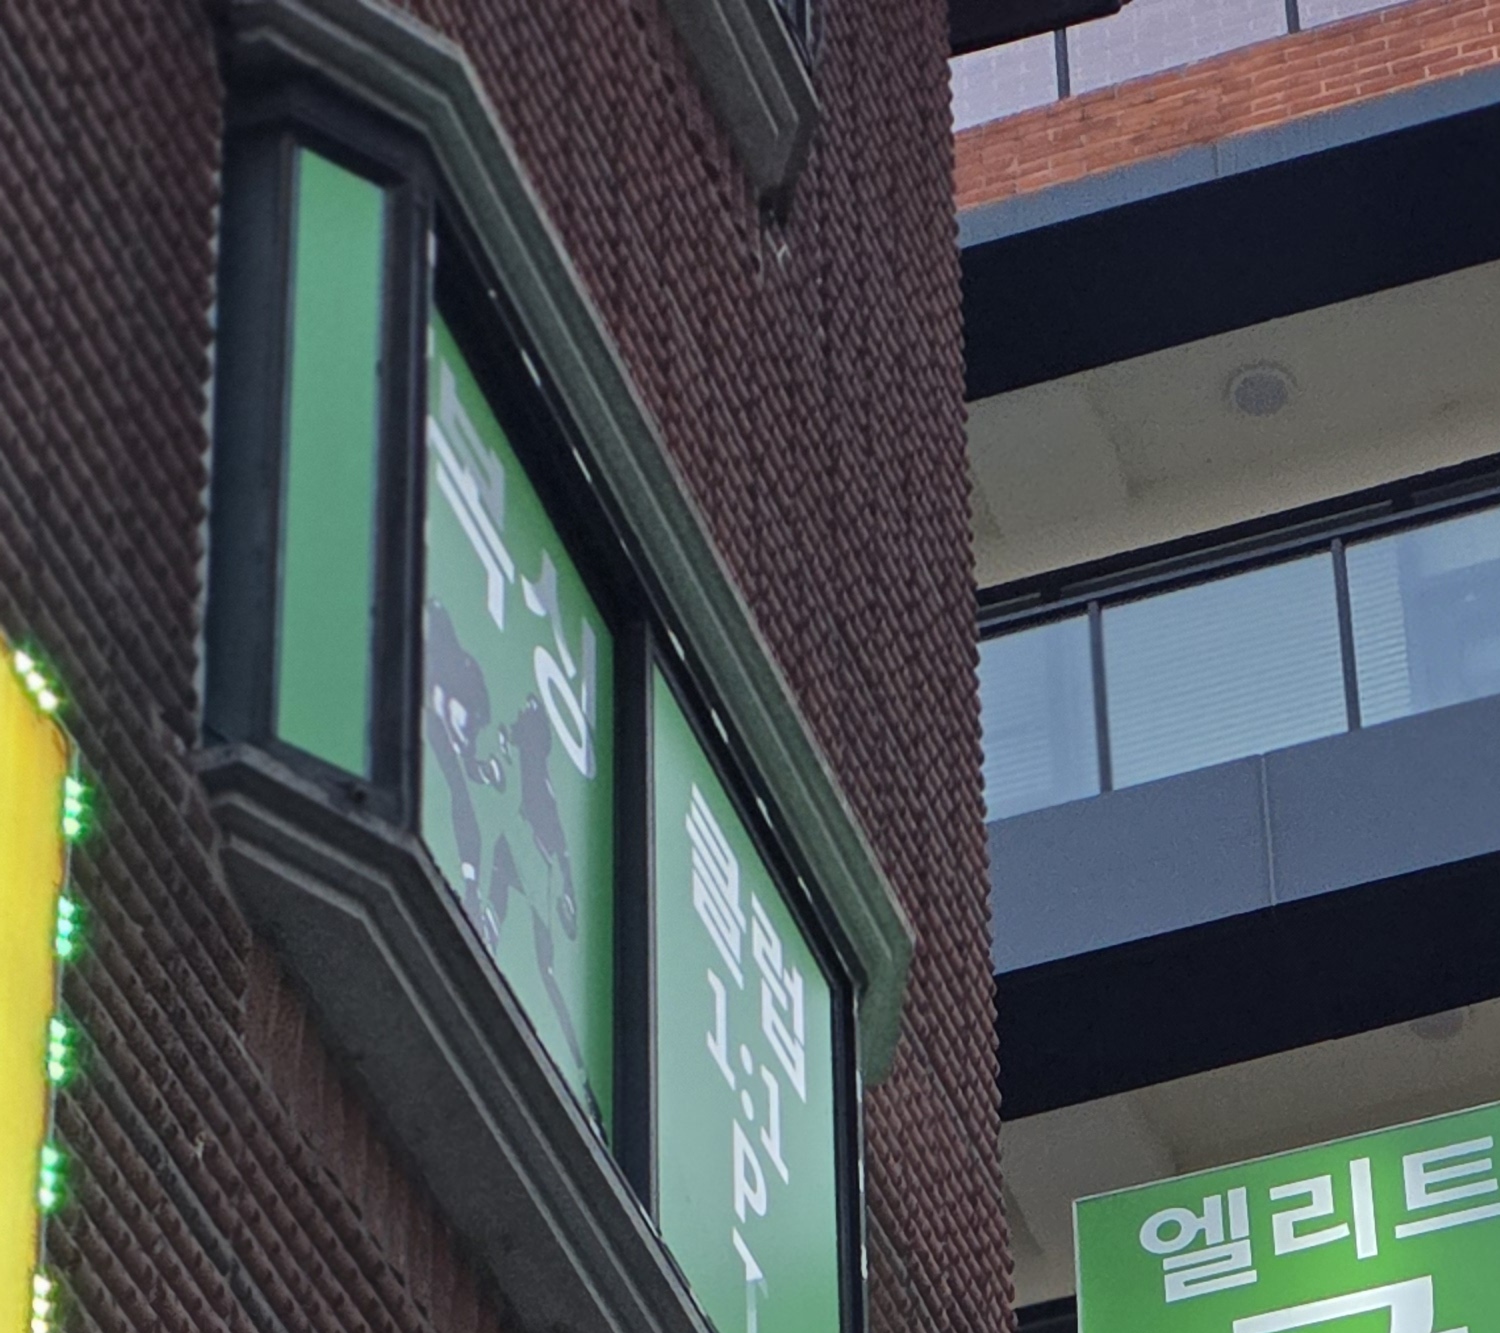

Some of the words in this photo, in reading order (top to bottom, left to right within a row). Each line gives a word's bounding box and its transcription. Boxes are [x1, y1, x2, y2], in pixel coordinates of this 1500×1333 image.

[428, 356, 597, 779] 복싱
[685, 781, 807, 1101] 클럽
[706, 969, 789, 1183] 1:1
